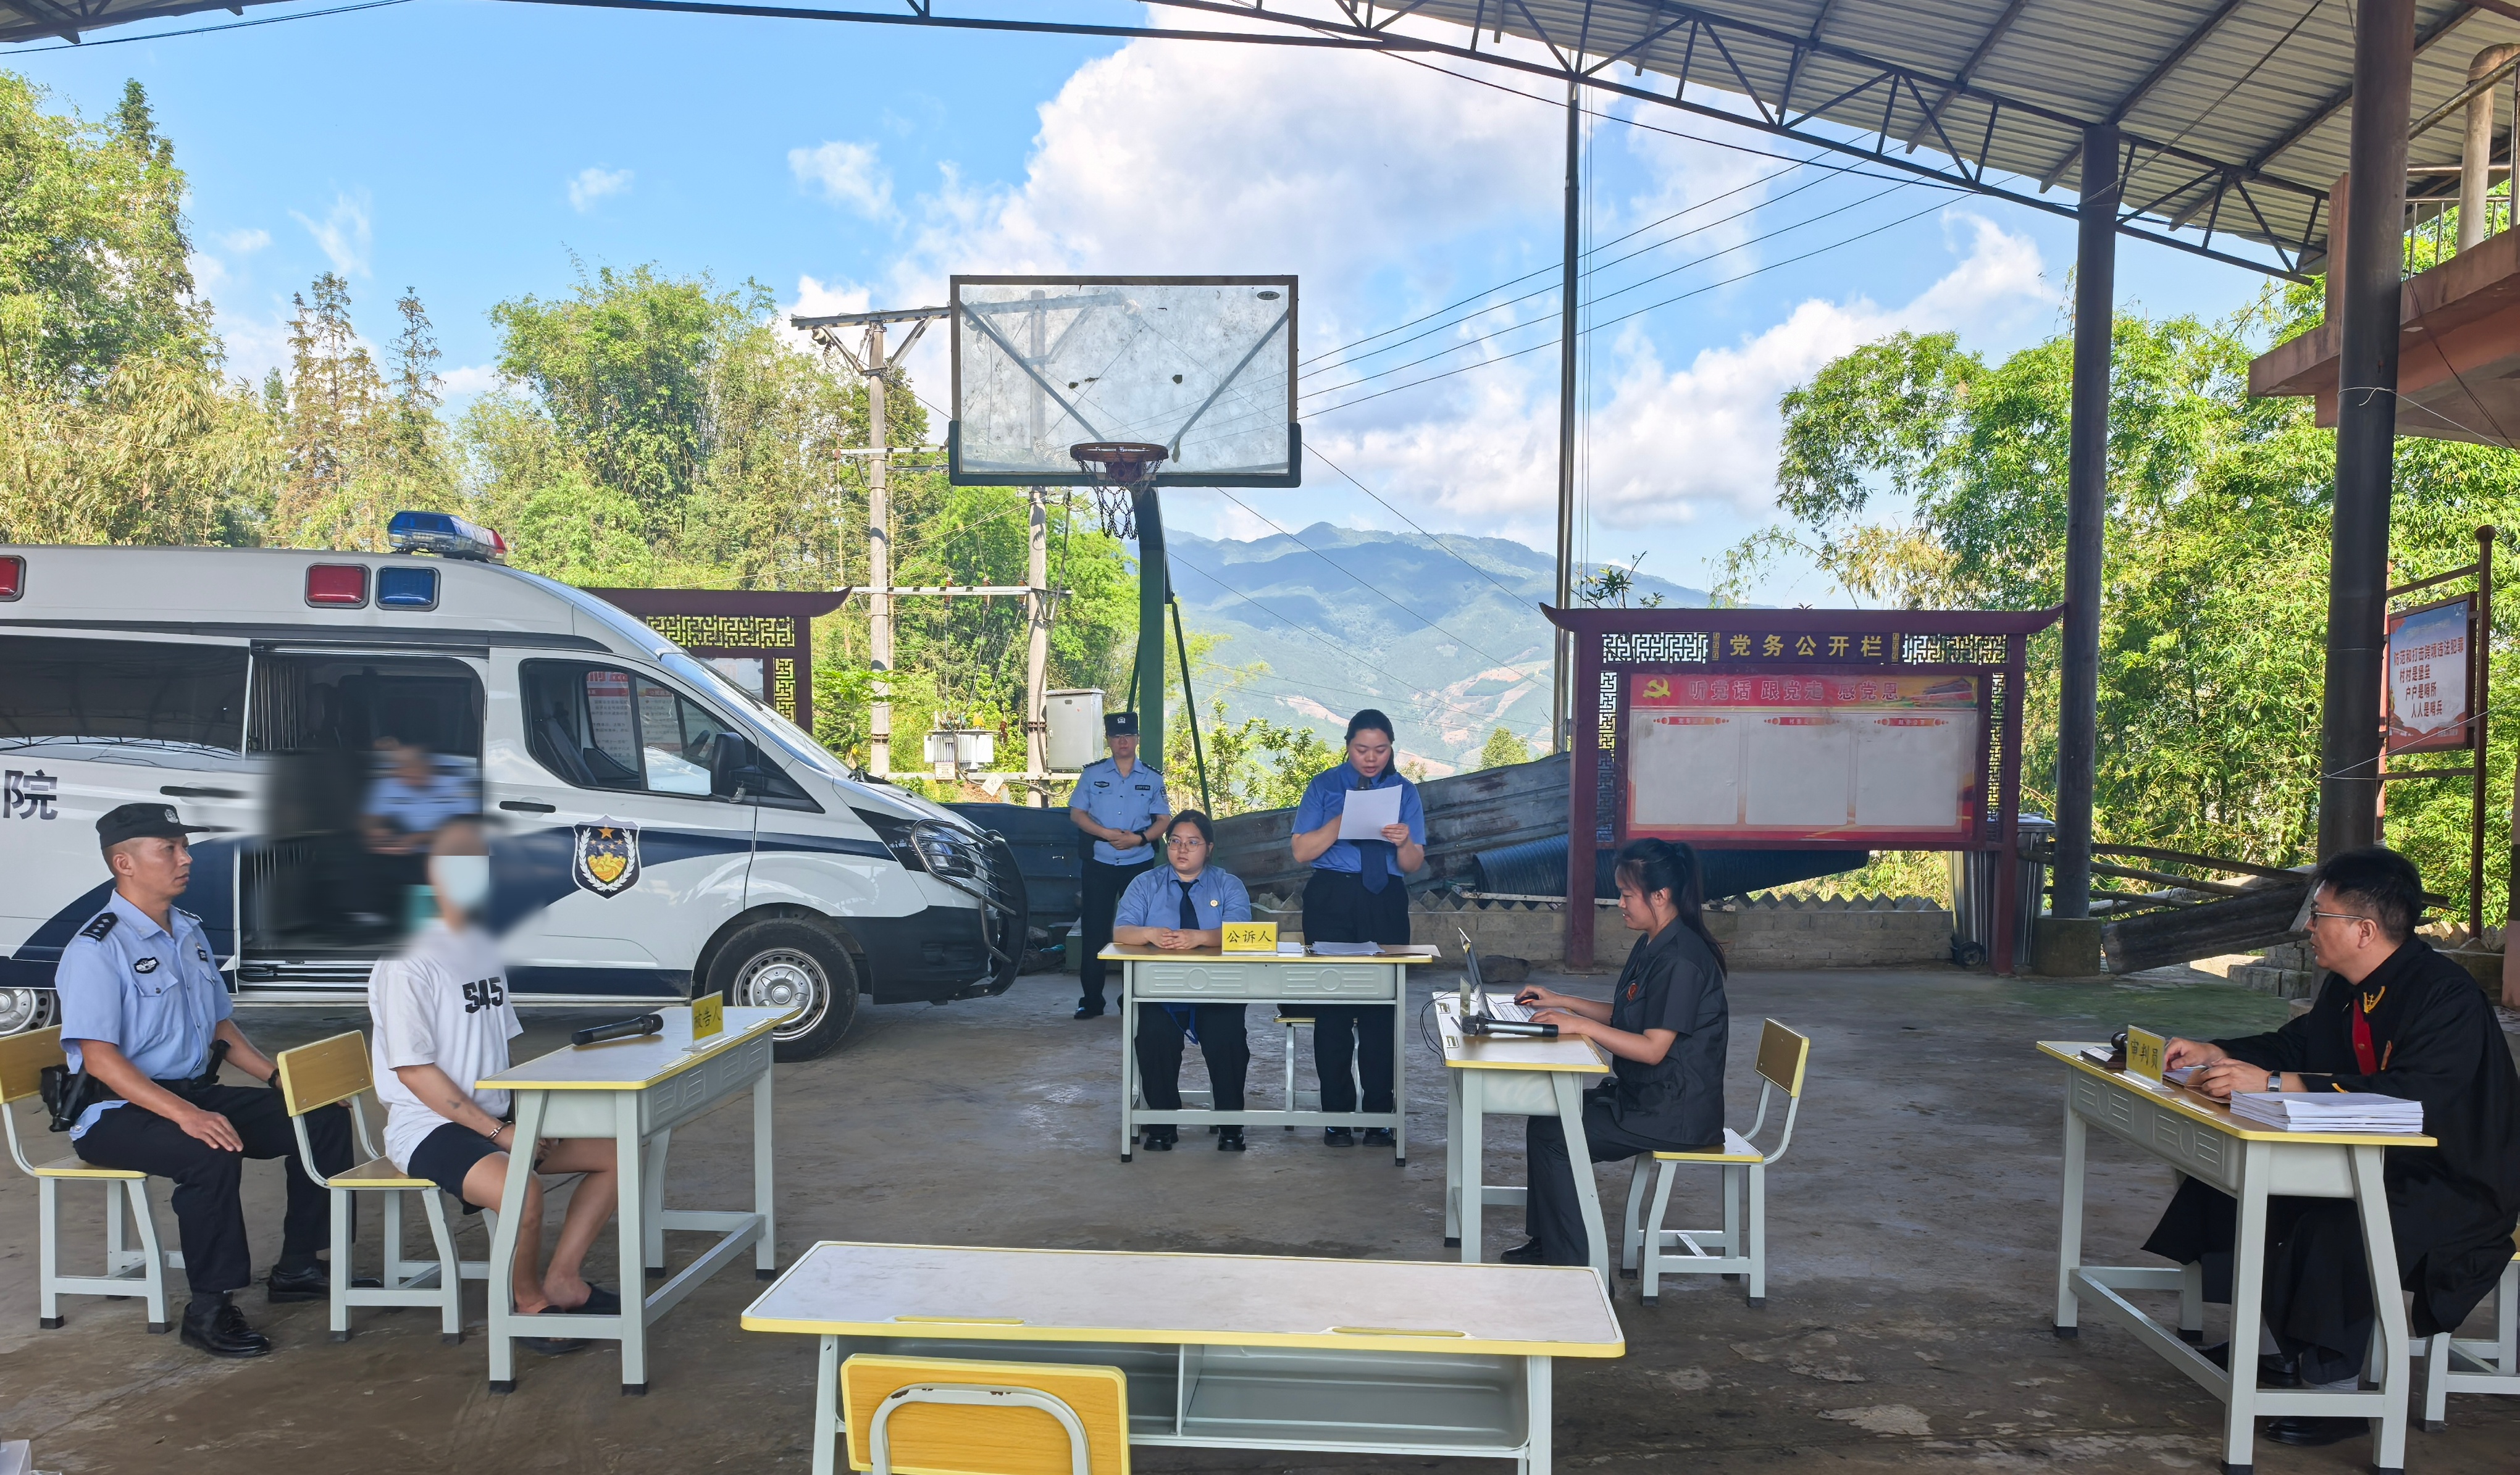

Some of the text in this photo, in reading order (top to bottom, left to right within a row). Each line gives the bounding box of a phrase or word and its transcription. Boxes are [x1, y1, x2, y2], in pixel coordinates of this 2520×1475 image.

[1730, 634, 1882, 657] 党务公开栏
[2393, 637, 2464, 666] 防范和打击跨境违法犯罪
[2400, 664, 2430, 683] 村村是堡垒
[1689, 680, 1899, 701] 听党话 跟党走 感党恩
[2405, 681, 2437, 701] 户户是哨所
[2411, 700, 2443, 718] 人人是哨兵
[3, 769, 58, 820] 院
[1226, 930, 1272, 943] 公诉人
[462, 976, 504, 1014] 545
[2130, 1038, 2158, 1070] 审判员
